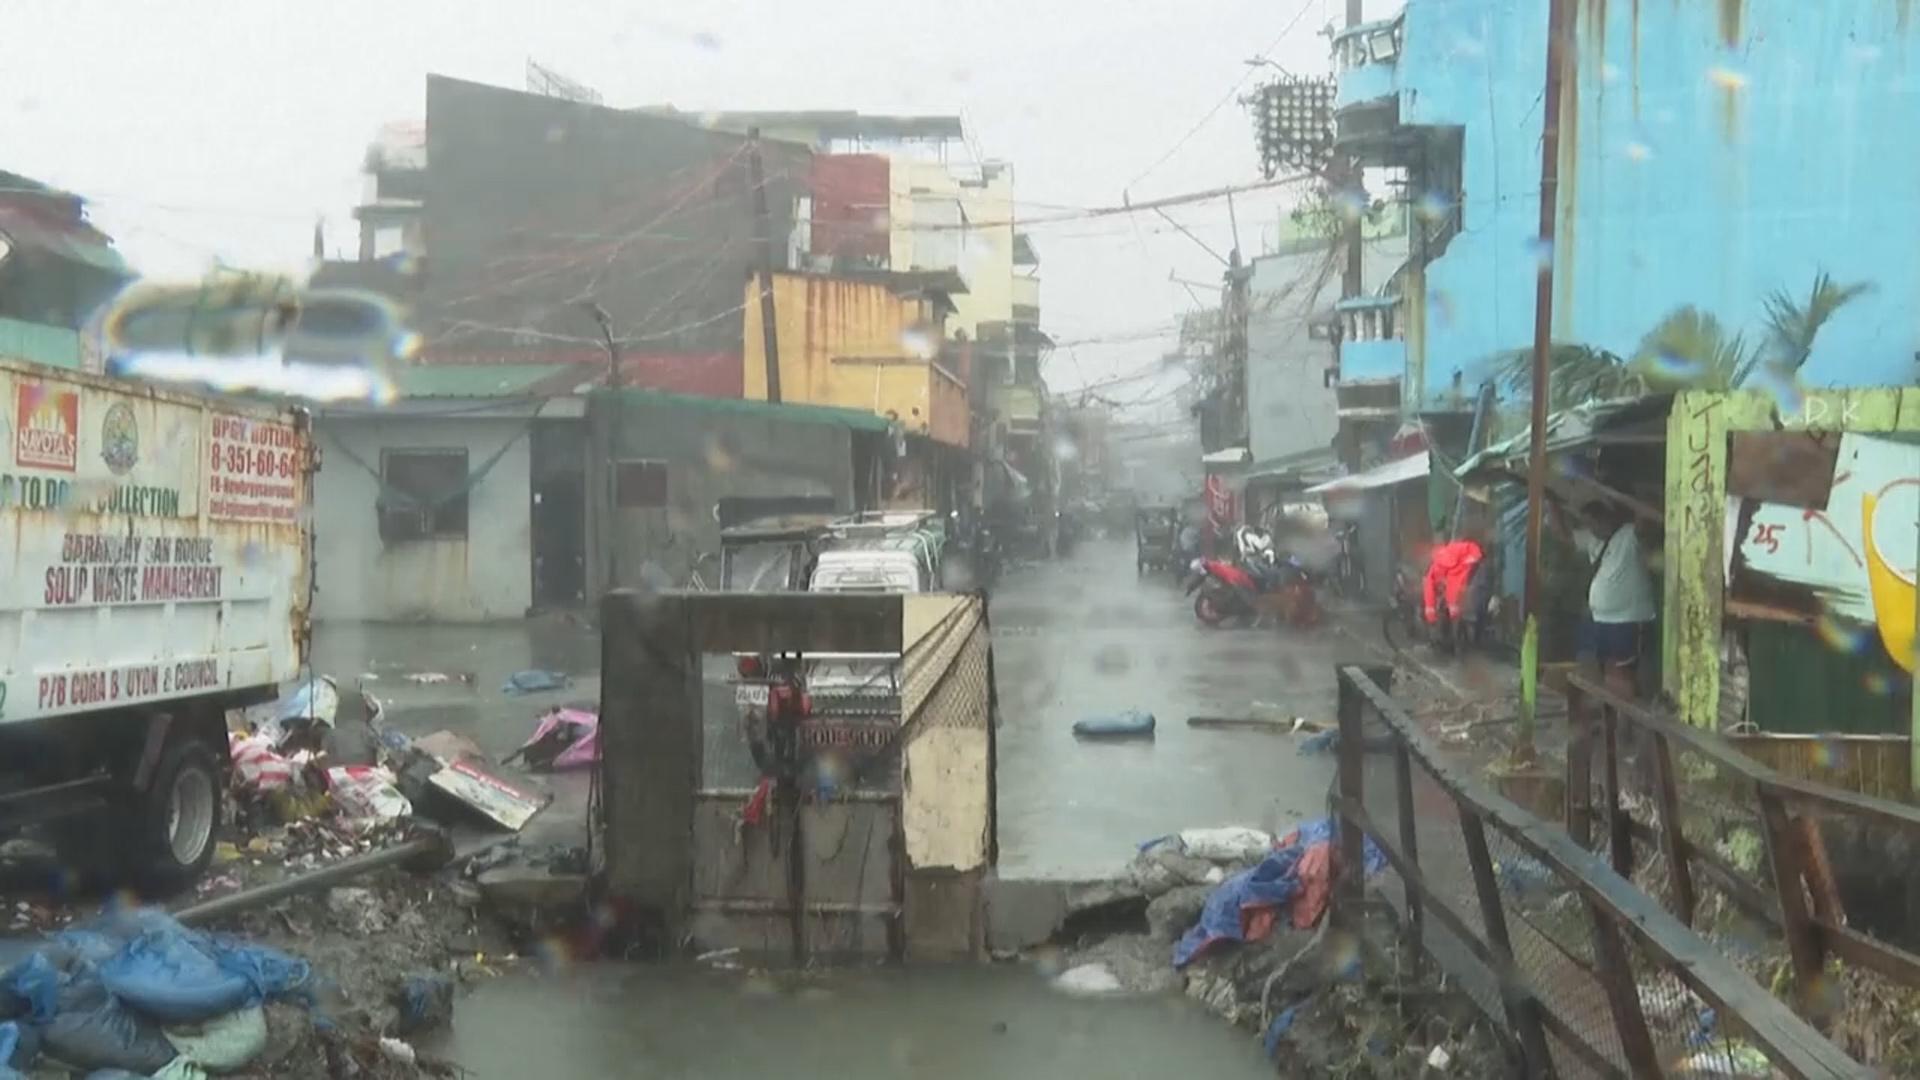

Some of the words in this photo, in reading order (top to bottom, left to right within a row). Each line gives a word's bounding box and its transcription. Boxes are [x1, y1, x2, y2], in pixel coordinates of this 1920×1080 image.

[19, 428, 75, 456] NAVOTAS
[211, 443, 296, 480] 8-351-60-64
[175, 537, 213, 565] ROQUE
[1753, 523, 1786, 554] 25
[92, 565, 138, 602] WASTE
[142, 565, 222, 600] MANAGEMENT
[38, 674, 66, 709] P/B
[71, 670, 106, 705] CORA
[175, 659, 218, 691] COUNCIL
